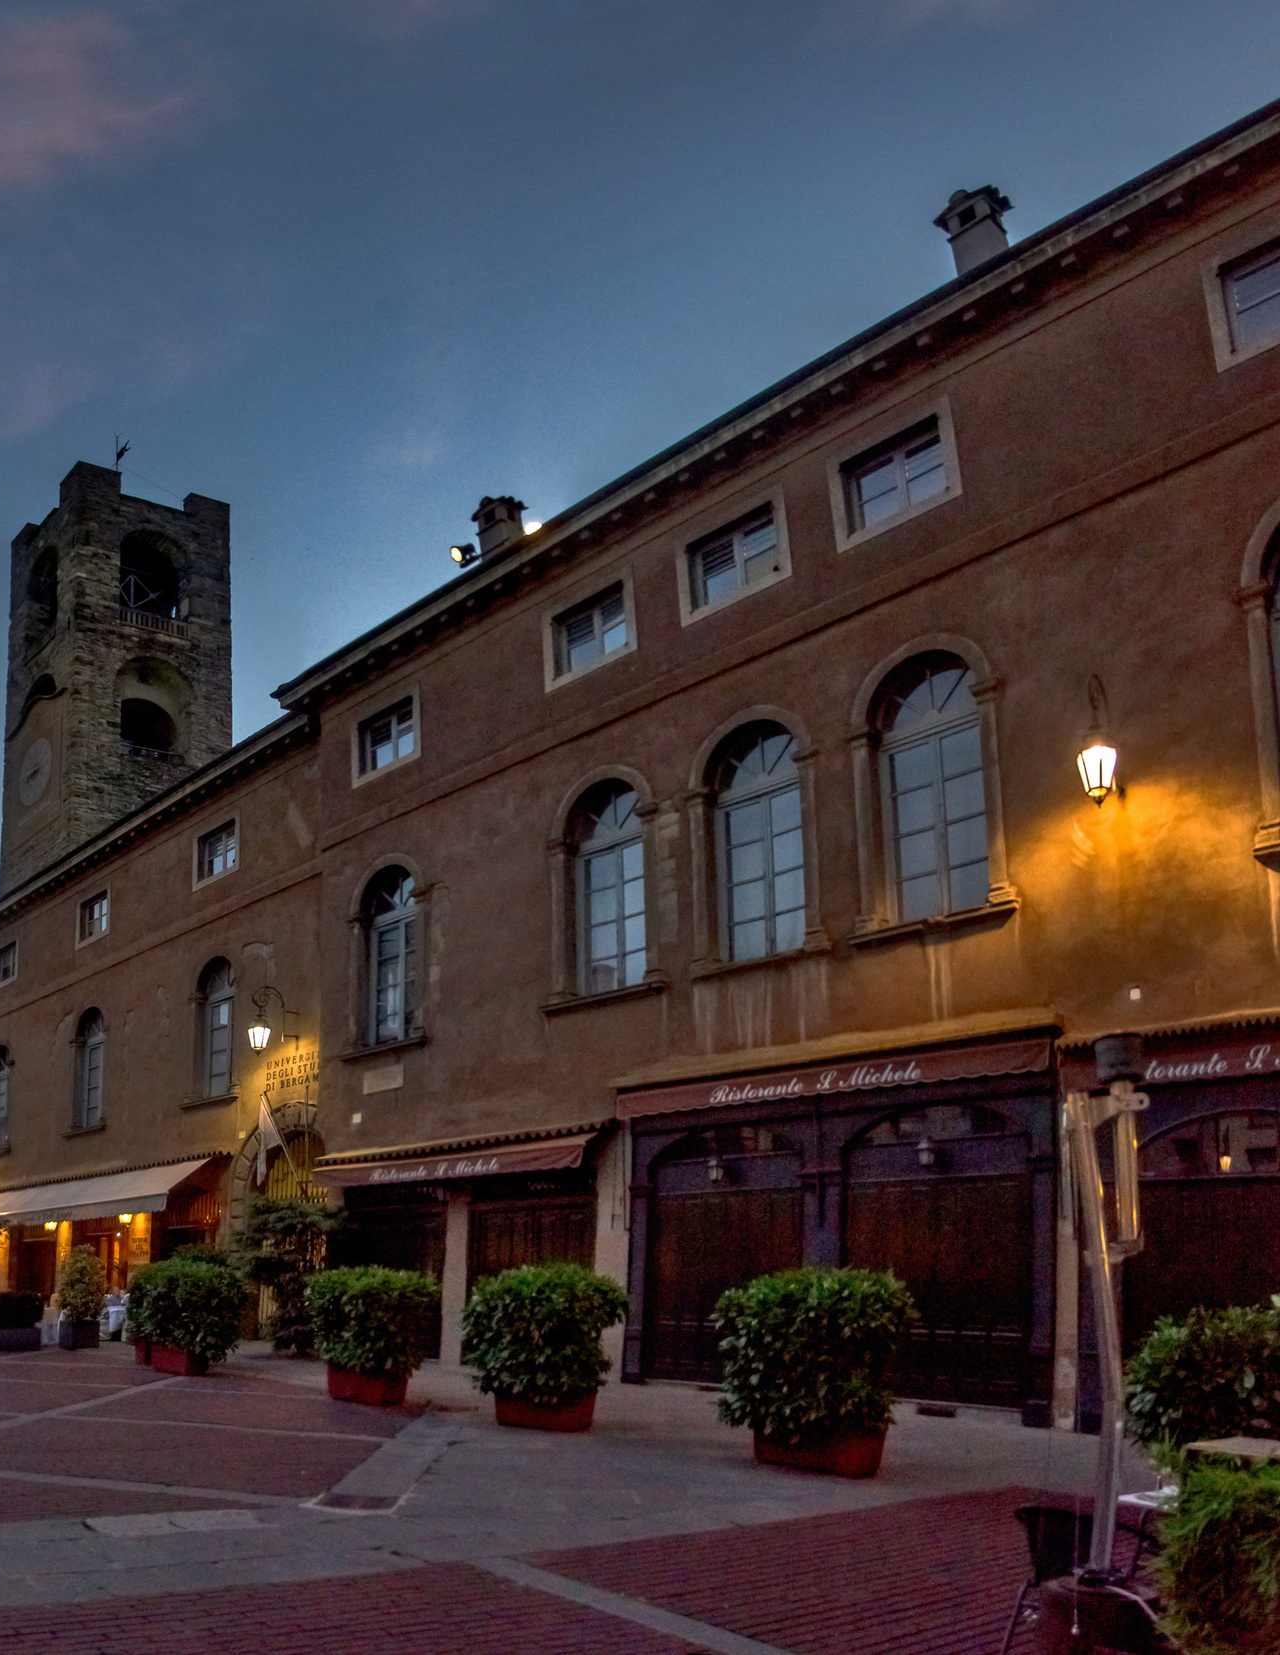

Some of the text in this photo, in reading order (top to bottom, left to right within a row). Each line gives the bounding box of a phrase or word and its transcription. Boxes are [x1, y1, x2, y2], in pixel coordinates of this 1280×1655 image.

[266, 1050, 320, 1071] UNIVERSIT
[266, 1062, 320, 1082] DEGLI STU
[1145, 1053, 1229, 1079] torante
[265, 1072, 320, 1093] DI BERGAM
[709, 1077, 804, 1104] Ristorante
[839, 1061, 922, 1088] Michele
[369, 1165, 428, 1182] Ristorante
[448, 1157, 500, 1176] Michele
